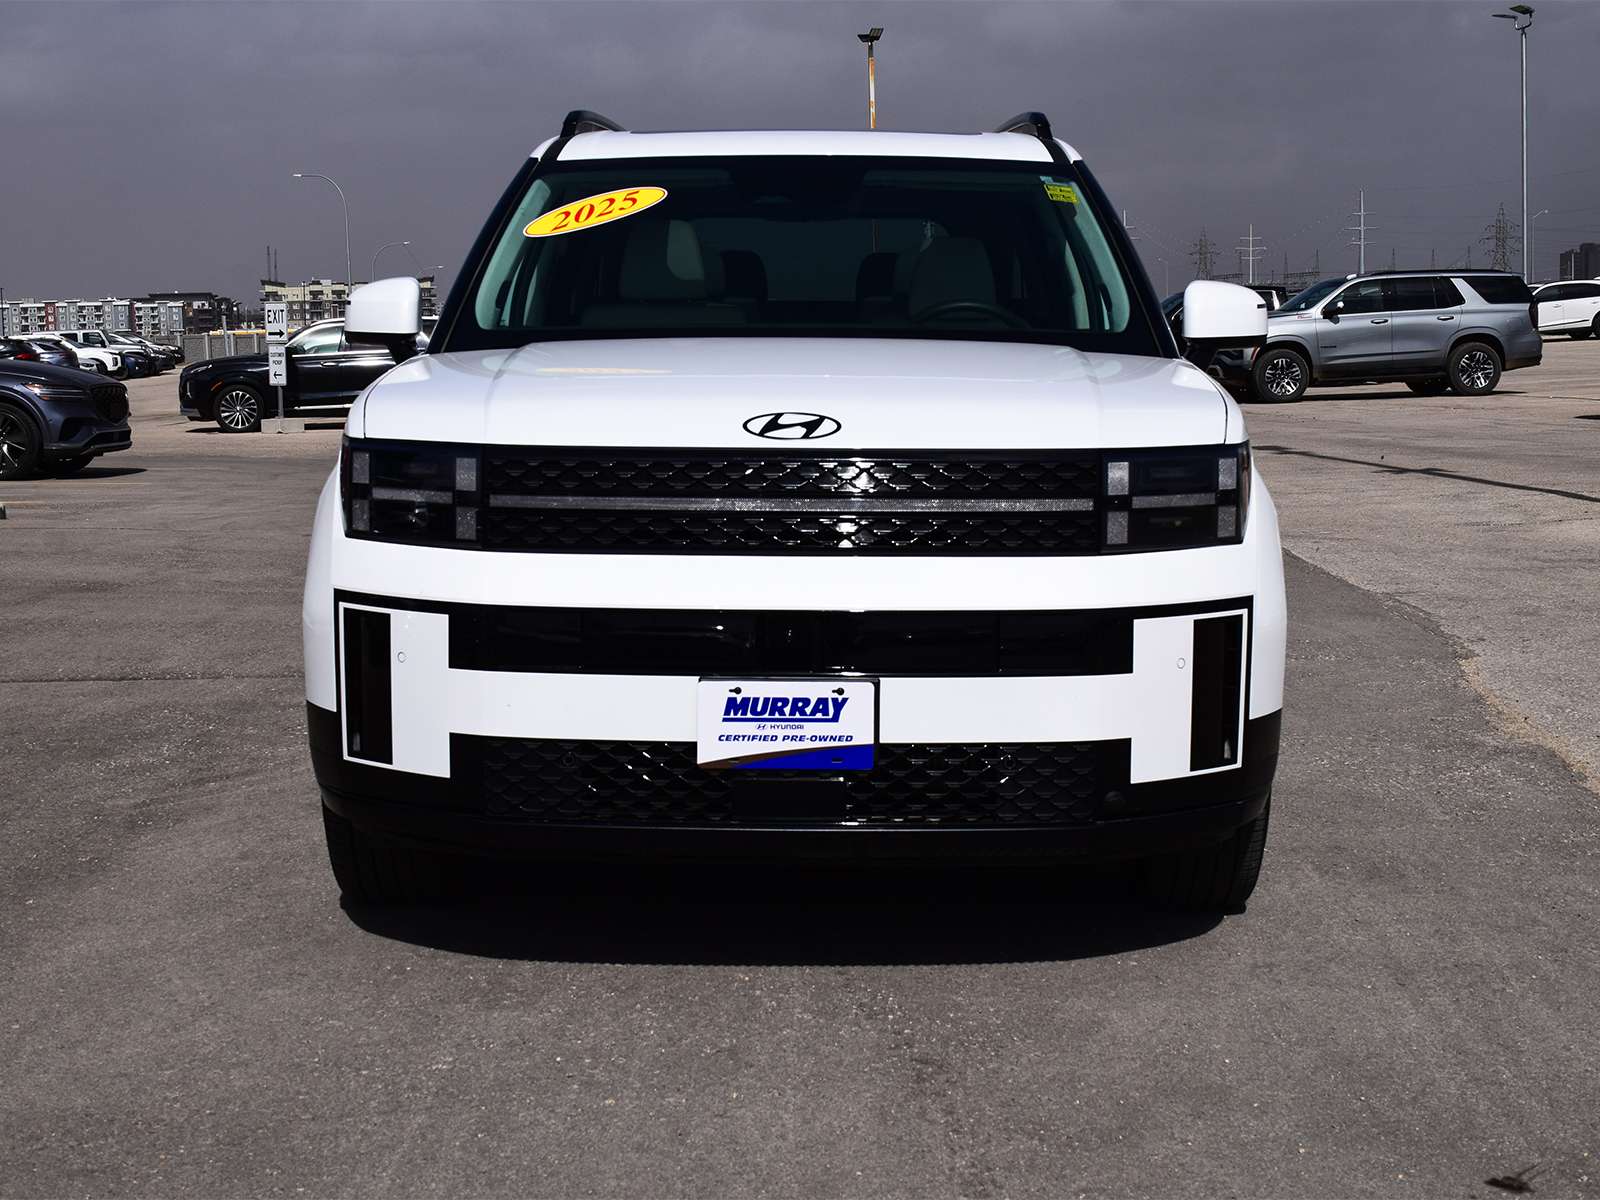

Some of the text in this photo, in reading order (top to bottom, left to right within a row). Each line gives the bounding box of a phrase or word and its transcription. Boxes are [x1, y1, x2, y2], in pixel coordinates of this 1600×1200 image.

[551, 190, 639, 232] 2025
[267, 309, 285, 324] EXIT
[722, 696, 850, 722] MURRAY
[718, 734, 778, 742] CERTIFIED
